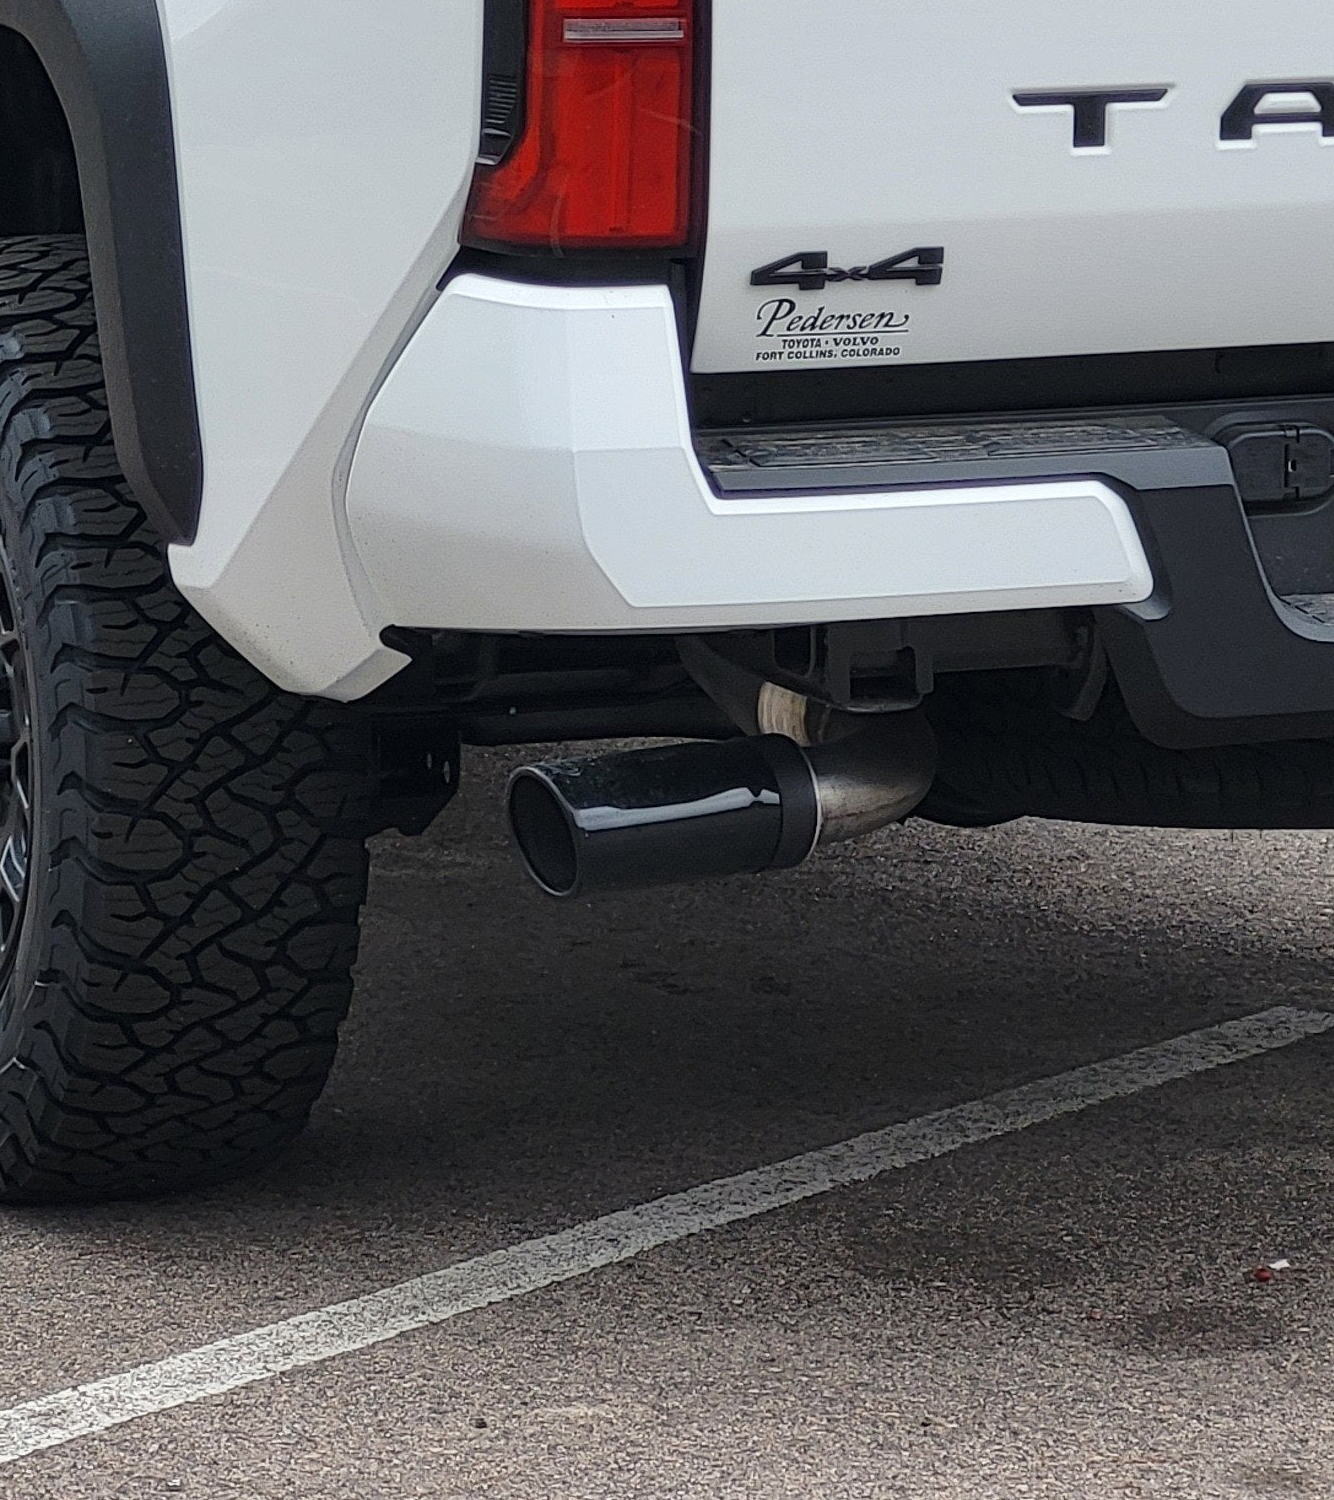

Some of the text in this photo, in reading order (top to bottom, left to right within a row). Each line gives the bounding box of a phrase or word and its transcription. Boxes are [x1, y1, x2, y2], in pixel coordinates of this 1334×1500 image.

[756, 298, 910, 338] Pedersen
[781, 336, 879, 350] TOYOTA VOLVO
[755, 350, 782, 361] FORT
[840, 347, 900, 358] COLORADO
